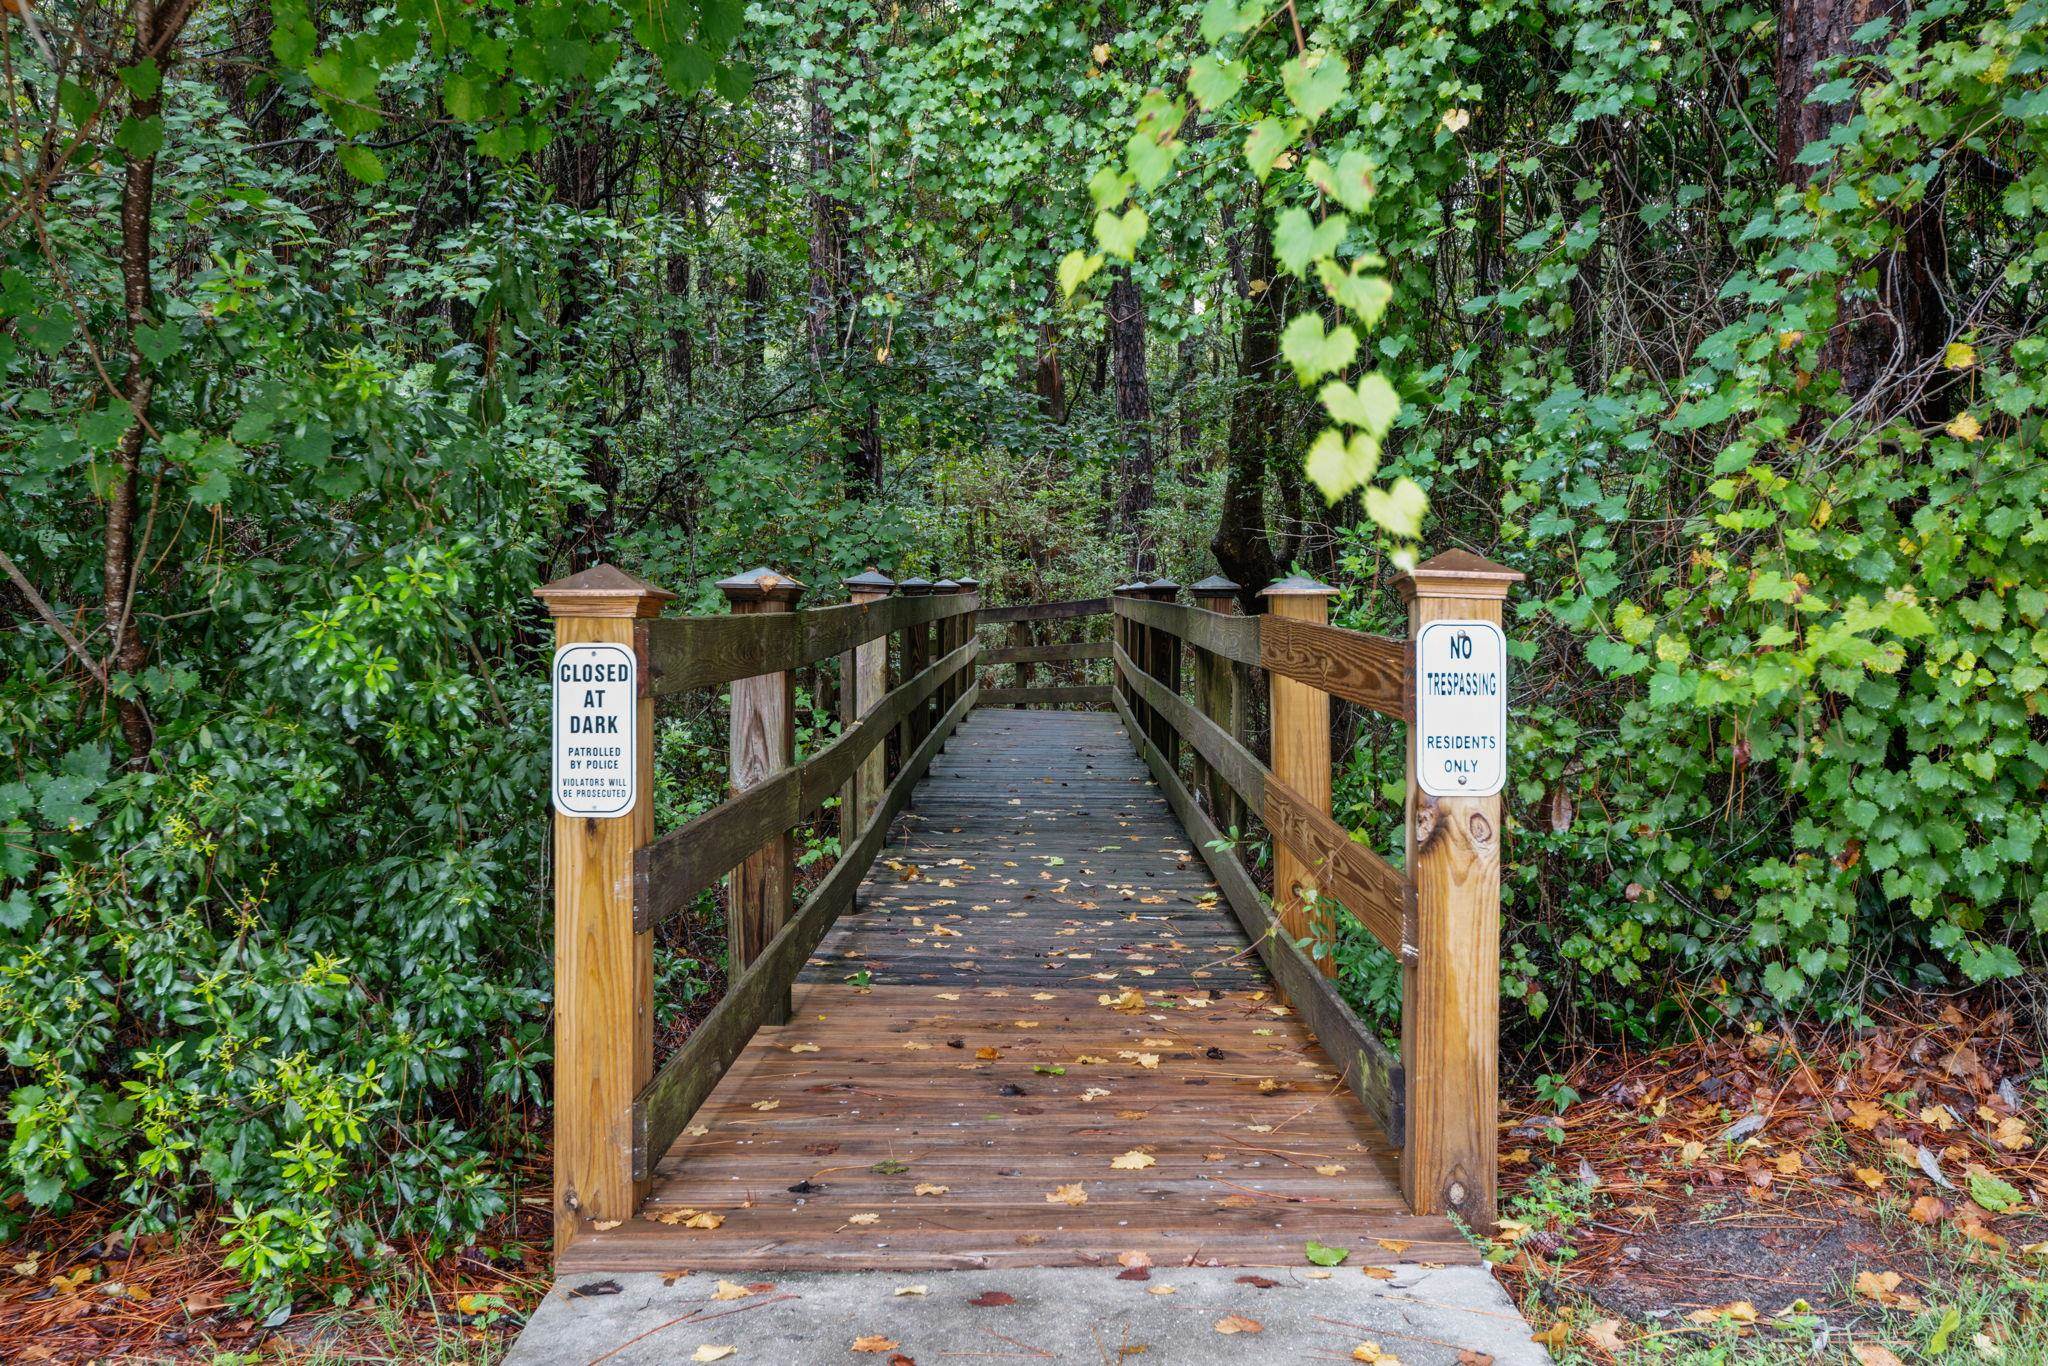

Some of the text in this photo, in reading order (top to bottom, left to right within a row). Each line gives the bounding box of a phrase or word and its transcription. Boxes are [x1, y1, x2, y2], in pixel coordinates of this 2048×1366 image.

[1450, 635, 1472, 660] NO
[560, 664, 629, 683] CLOSED
[1427, 672, 1496, 696] TRESPASSING
[584, 689, 606, 708] AT
[570, 715, 618, 734] DARK
[1427, 735, 1496, 749] RESIDENTS
[568, 747, 621, 757] PATROLLED
[570, 760, 619, 769] BY POLICE
[1444, 759, 1478, 773] ONLY
[562, 778, 627, 787] VIOLATORS WILL
[563, 789, 627, 798] BE PROSECUTED
